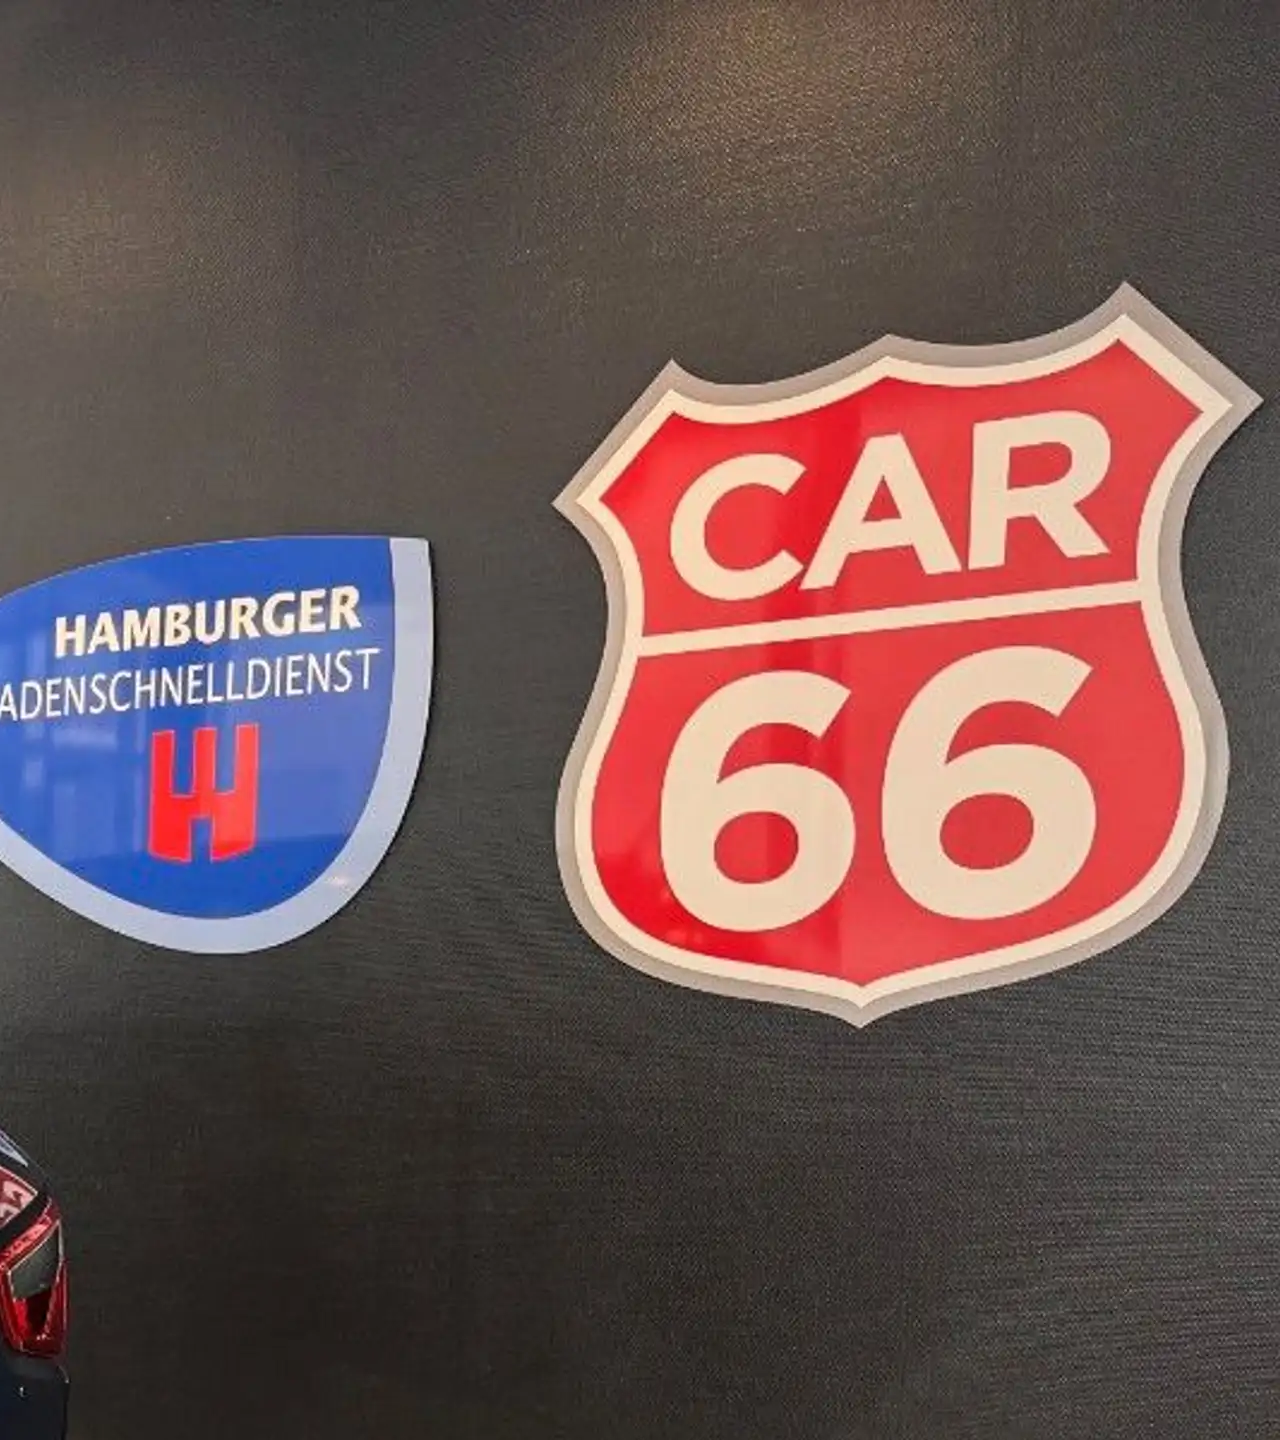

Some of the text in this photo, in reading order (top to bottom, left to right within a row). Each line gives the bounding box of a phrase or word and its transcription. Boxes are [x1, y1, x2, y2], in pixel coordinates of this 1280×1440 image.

[669, 409, 1112, 601] CAR
[54, 585, 363, 658] HAMBURGER
[659, 644, 1097, 933] 66
